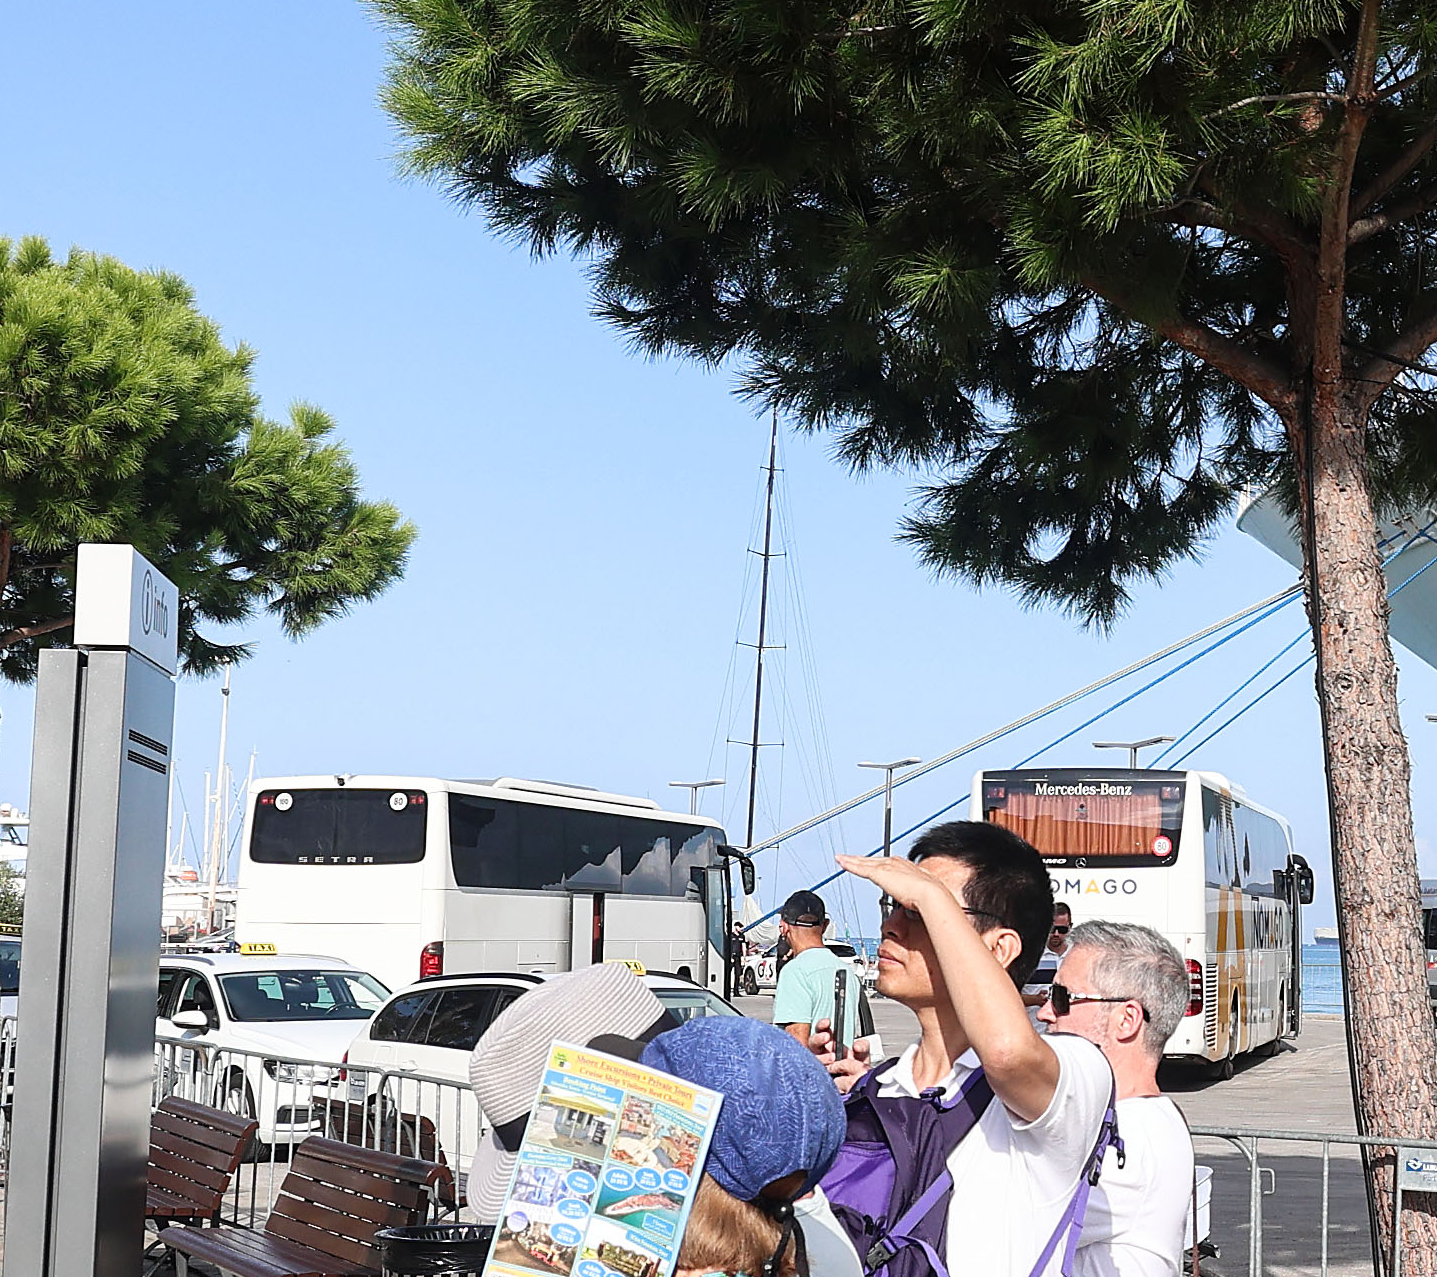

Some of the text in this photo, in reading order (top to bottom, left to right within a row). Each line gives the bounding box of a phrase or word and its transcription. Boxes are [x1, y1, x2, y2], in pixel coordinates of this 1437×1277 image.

[152, 585, 169, 639] info
[1034, 783, 1133, 797] Mercedes-Benz
[1156, 841, 1167, 851] 80
[1050, 879, 1138, 895] OMAGO
[1253, 900, 1284, 950] NOMAGO
[248, 943, 275, 952] TAXI
